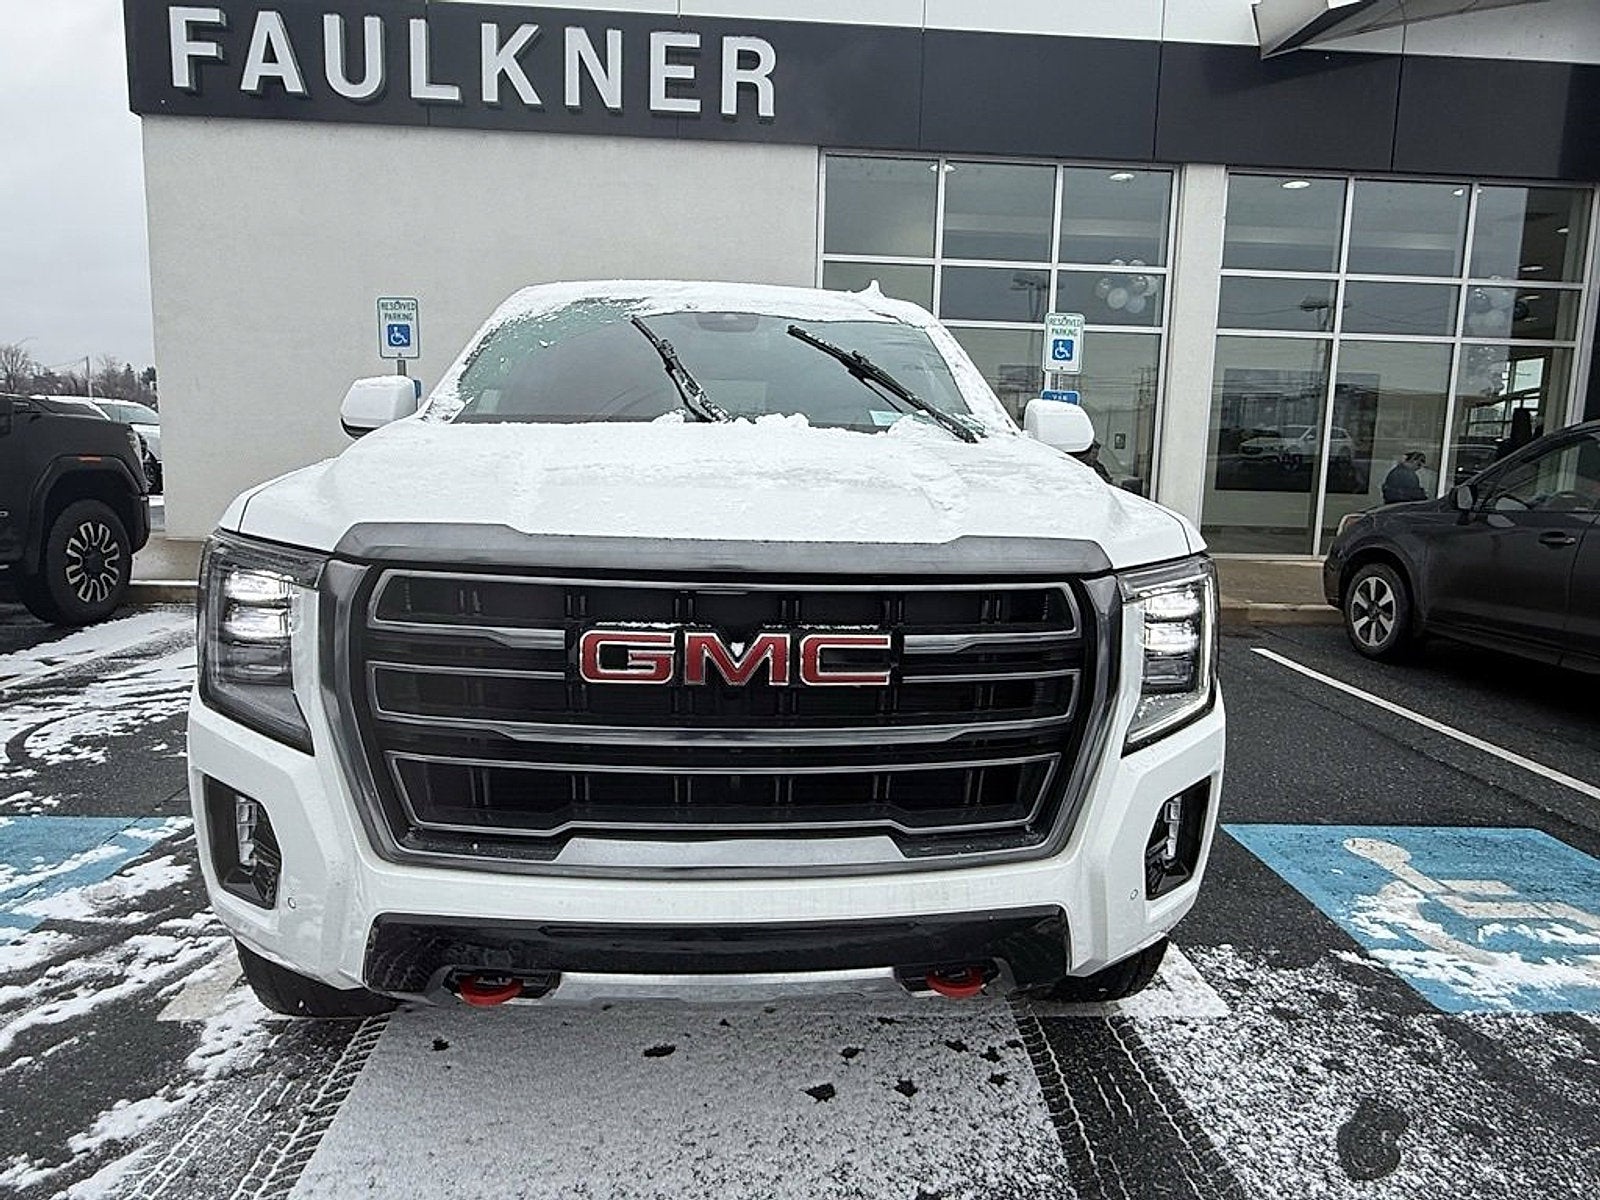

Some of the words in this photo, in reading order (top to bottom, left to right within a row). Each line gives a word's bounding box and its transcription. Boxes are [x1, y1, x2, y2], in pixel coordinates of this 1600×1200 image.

[169, 6, 776, 118] FAULKNER
[381, 301, 416, 310] RESERVED
[384, 313, 413, 321] PARKING
[579, 629, 892, 686] GMC
